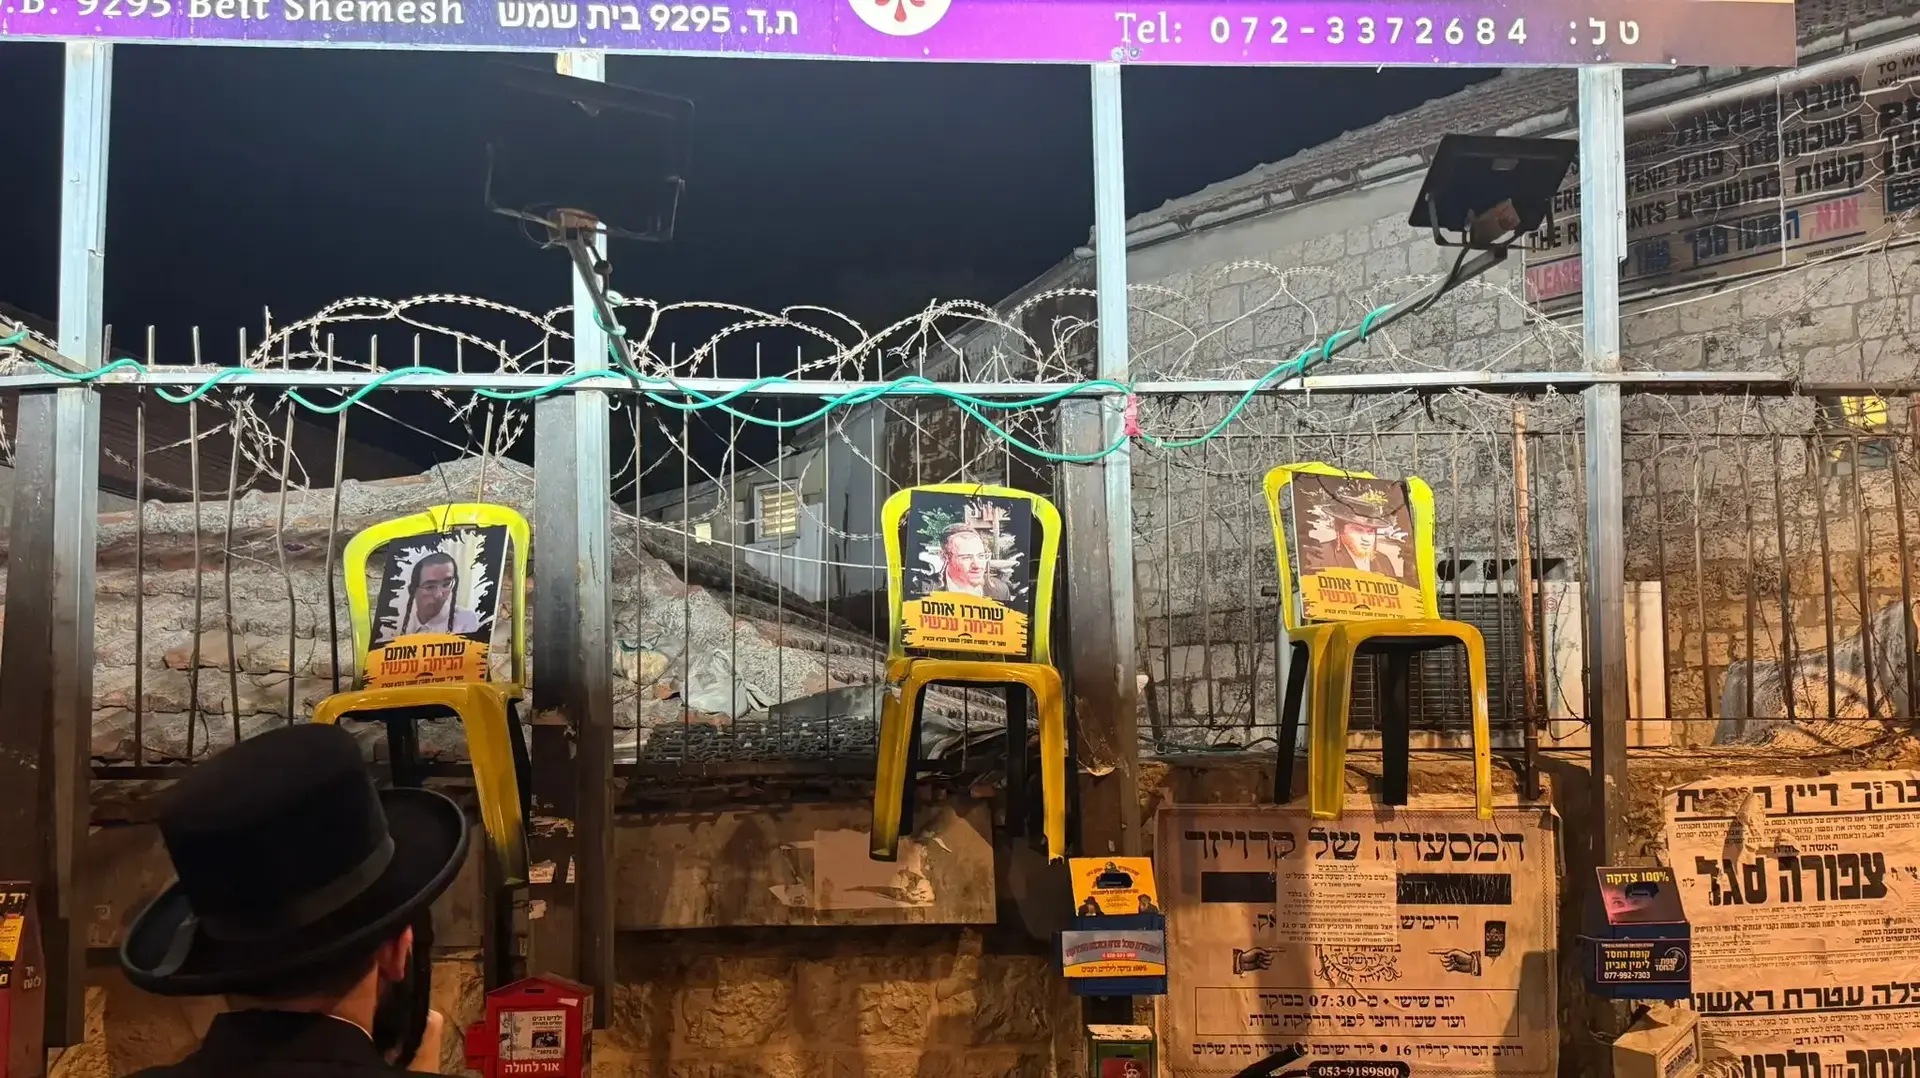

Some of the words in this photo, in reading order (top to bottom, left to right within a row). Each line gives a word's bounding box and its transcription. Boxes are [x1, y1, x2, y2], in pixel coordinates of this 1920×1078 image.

[77, 0, 171, 17] 9295
[188, 0, 269, 20] Beit
[285, 0, 464, 24] Shemesh
[500, 3, 577, 29] שמש
[587, 6, 641, 31] בית
[650, 8, 730, 33] 9295
[740, 9, 798, 35] ת.ד.
[1115, 12, 1182, 44] Tel:
[1210, 17, 1528, 45] 072-3372684
[1877, 61, 1897, 74] TO
[1794, 152, 1865, 190] קשות
[1808, 198, 1860, 240] אנא,
[1317, 575, 1351, 591] אותם
[1355, 579, 1399, 596] שחררו
[1319, 588, 1357, 605] עכשיו
[1361, 592, 1401, 609] הביתה
[921, 600, 955, 617] אותם
[960, 604, 1004, 621] שחררו
[919, 614, 959, 632] עכשיו
[964, 619, 1004, 636] הביתה
[384, 644, 417, 660] אותם
[423, 641, 466, 659] שחררו
[380, 659, 419, 676] עכשיו
[423, 656, 464, 672] הביתה
[1784, 783, 1839, 814] דיין
[1867, 814, 1881, 822] קודר
[1185, 830, 1295, 871] קרויזר
[1308, 827, 1360, 860] של
[1374, 832, 1524, 861] המסעדה
[1809, 843, 1838, 852] האשה
[1606, 873, 1638, 886] צדקה
[1695, 855, 1768, 906] סגל
[1778, 852, 1888, 902] צפורה
[1605, 950, 1628, 959] החסד
[1629, 950, 1650, 960] קופת
[1605, 961, 1626, 970] אביון
[1629, 959, 1650, 970] לימין
[1604, 971, 1650, 979] 077-992-7303
[1259, 993, 1304, 1010] בבוקר
[1395, 995, 1431, 1008] שישי
[1434, 995, 1456, 1008] יום
[1783, 986, 1864, 1009] עטרת
[1250, 1014, 1279, 1027] נרות
[1284, 1012, 1332, 1030] הדלקת
[1336, 1013, 1365, 1028] לפני
[1369, 1015, 1401, 1028] וחצי
[1404, 1015, 1437, 1028] שעה
[1441, 1015, 1466, 1028] ועד
[1893, 1011, 1911, 1019] וביגון
[1734, 1019, 1755, 1027] אבינו,
[1810, 1025, 1823, 1033] לכל
[1792, 1036, 1811, 1045] רבי
[1192, 1042, 1226, 1055] שלום
[1230, 1043, 1251, 1055] בית
[1312, 1043, 1350, 1056] ישיבת
[1354, 1043, 1375, 1056] ליד
[1396, 1045, 1412, 1056] 16
[1416, 1043, 1450, 1059] קרלין
[1453, 1044, 1488, 1056] חסידי
[1493, 1044, 1524, 1057] רחוב
[505, 1061, 540, 1074] לחולה
[540, 1062, 560, 1072] אור
[1318, 1066, 1399, 1078] 053-9189800
